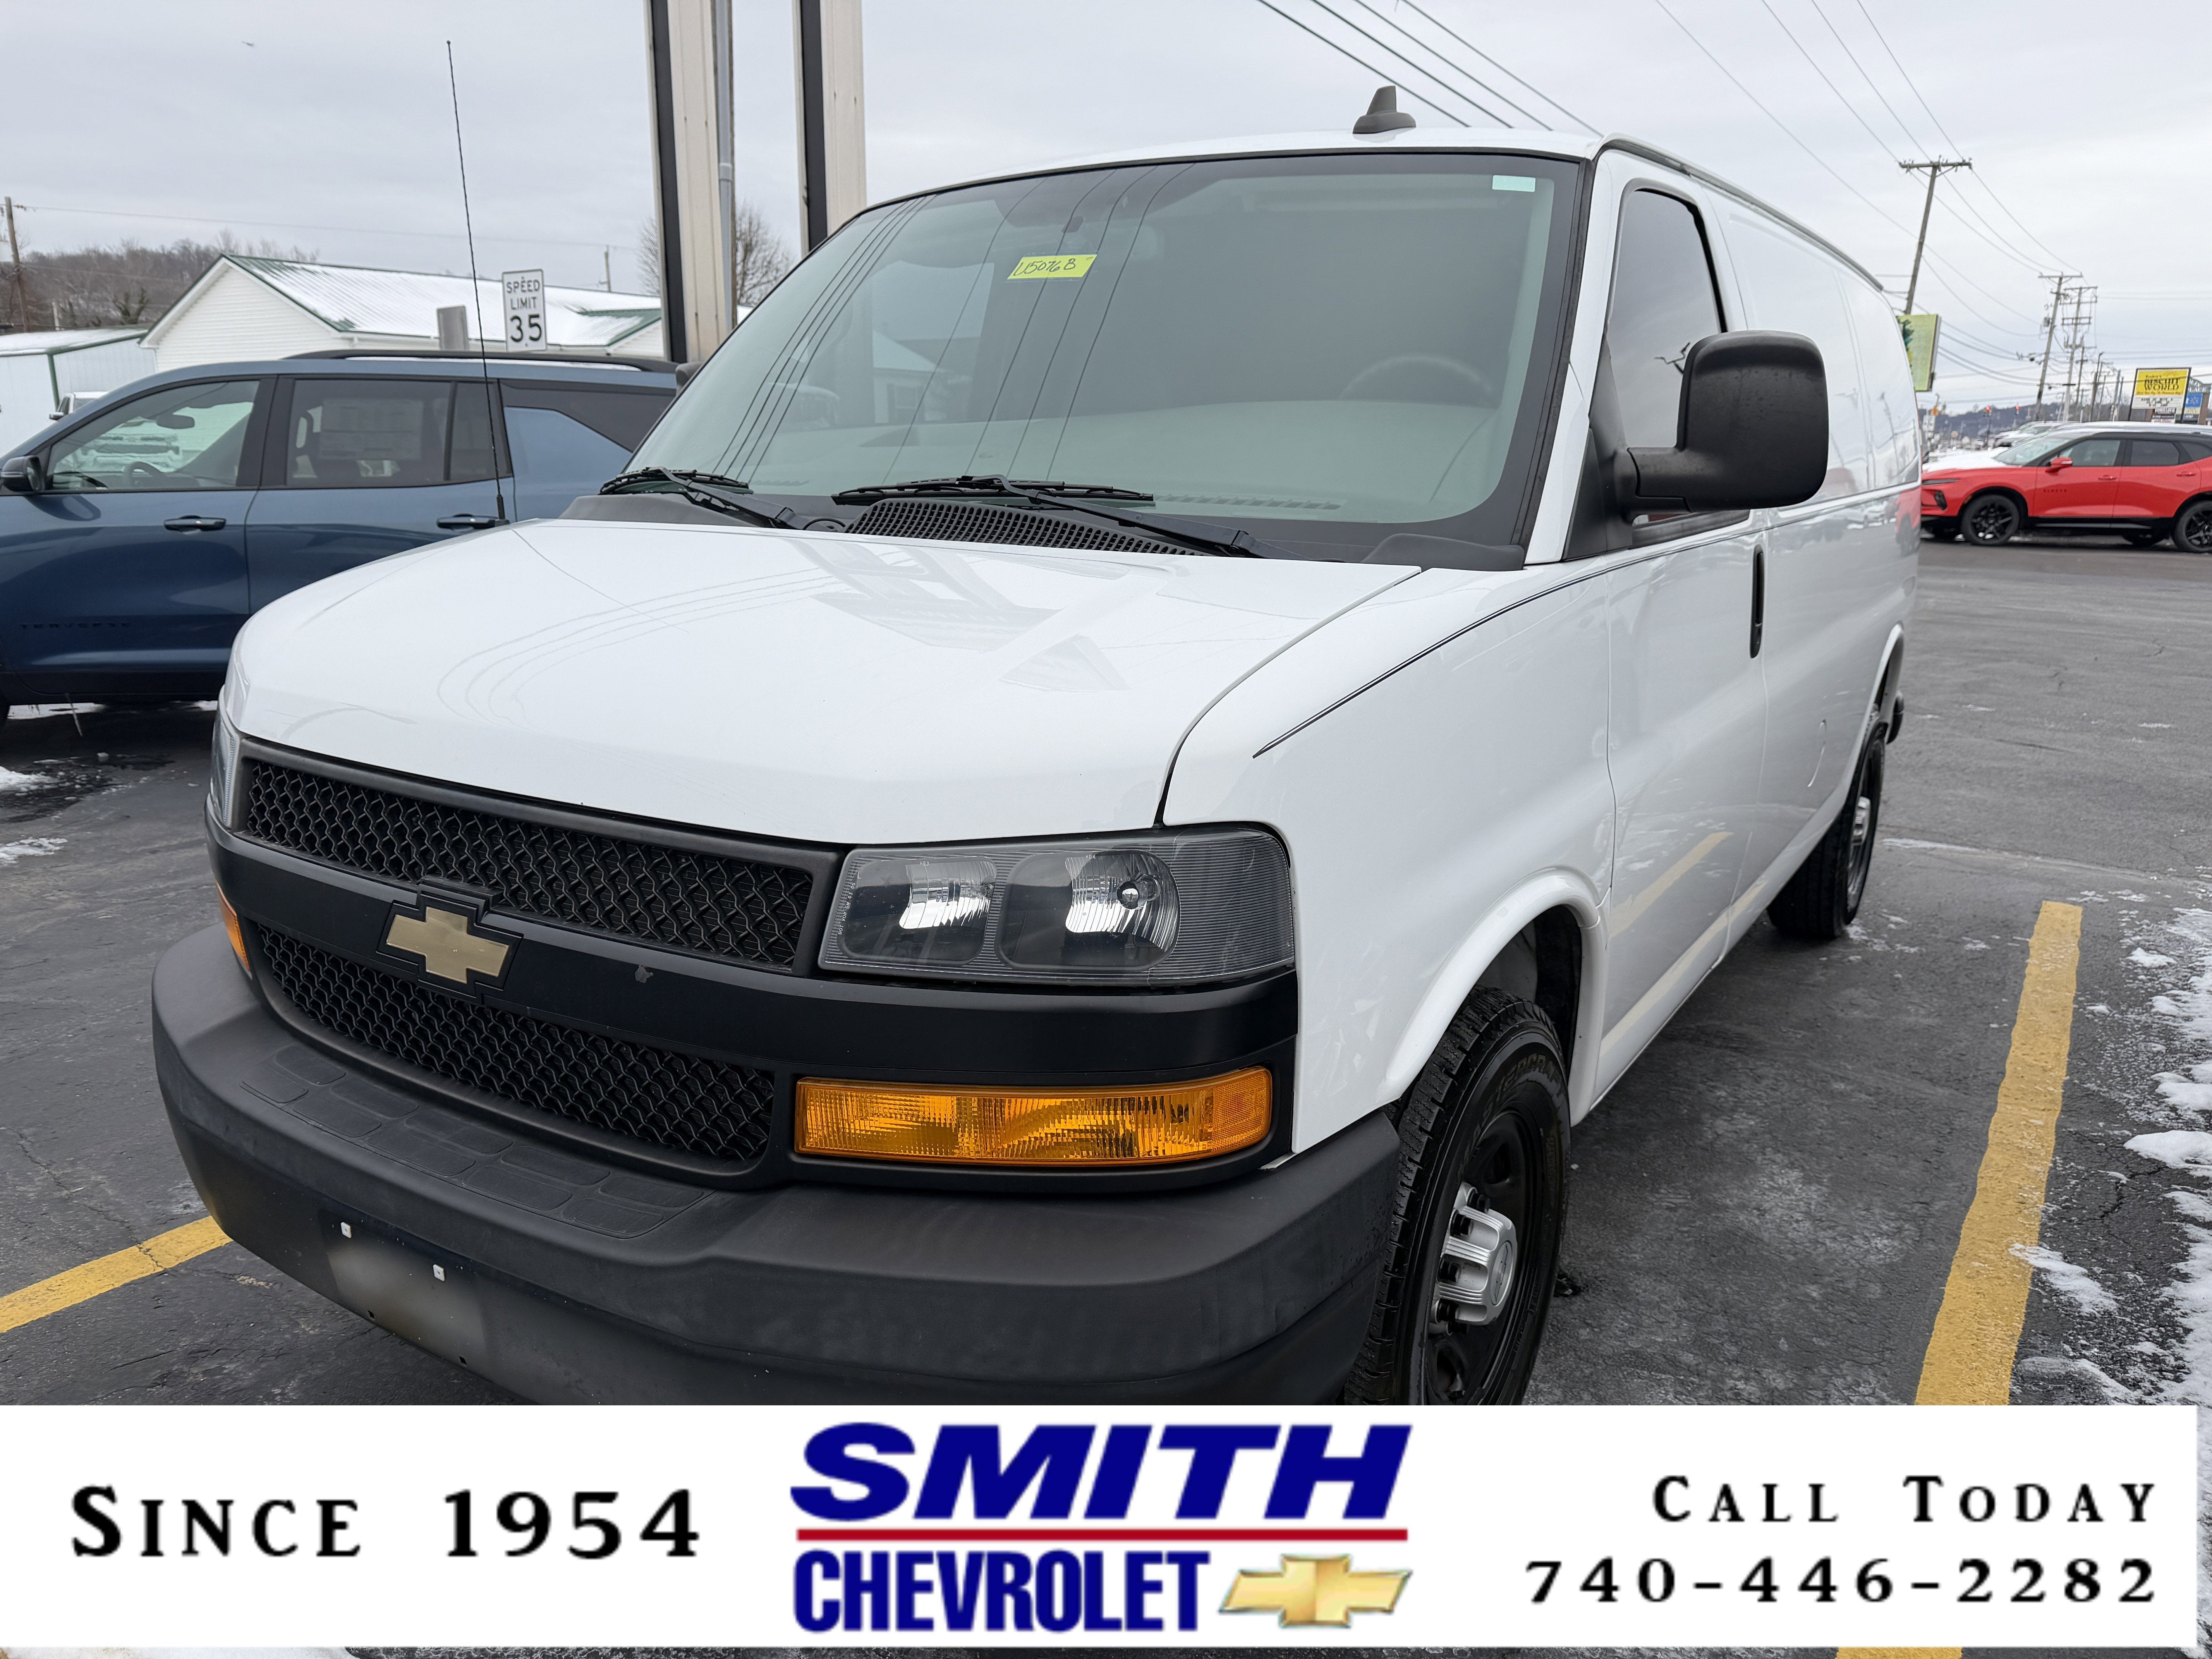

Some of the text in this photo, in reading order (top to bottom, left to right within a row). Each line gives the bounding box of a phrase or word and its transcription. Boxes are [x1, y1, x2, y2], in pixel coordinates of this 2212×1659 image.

[506, 279, 541, 294] SPEED
[510, 297, 538, 310] LIMIT
[510, 314, 542, 342] 35
